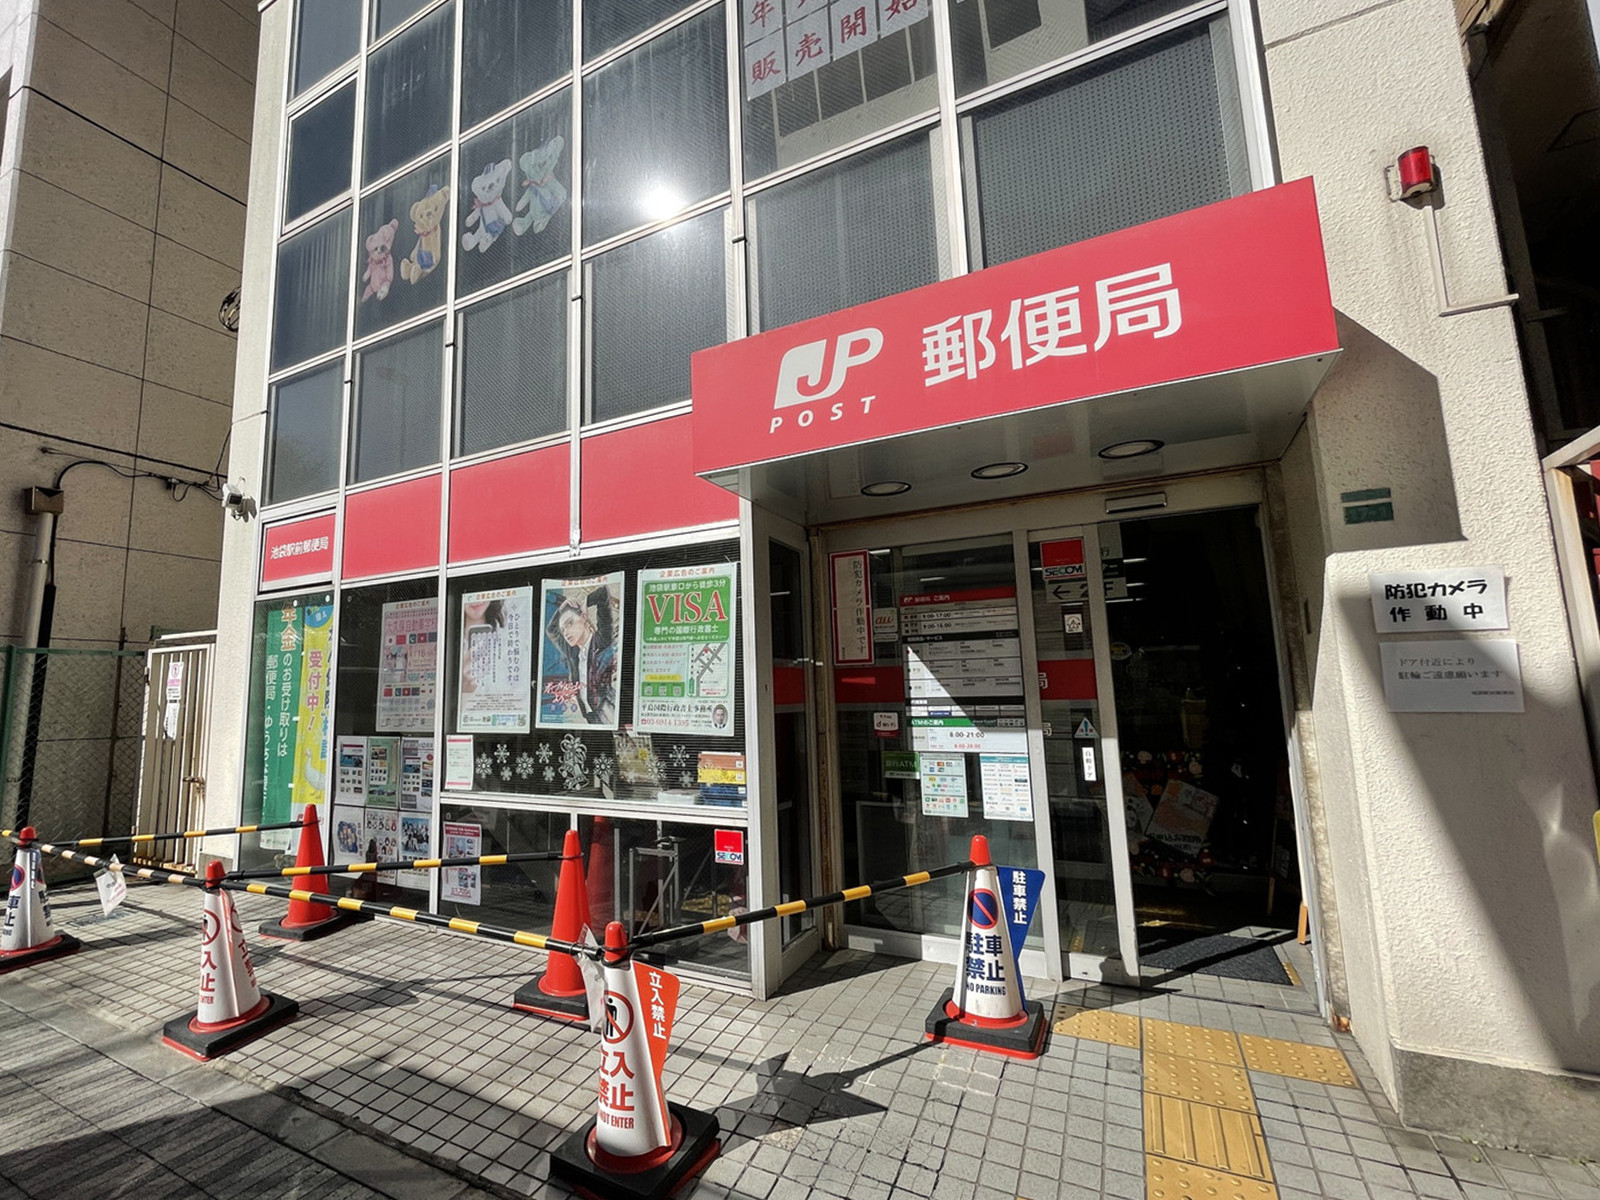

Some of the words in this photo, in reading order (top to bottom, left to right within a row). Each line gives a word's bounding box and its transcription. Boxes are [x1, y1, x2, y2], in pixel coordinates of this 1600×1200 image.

[751, 0, 919, 86] 販売開始
[922, 262, 1182, 388] 郵便局
[774, 327, 884, 410] JP
[769, 396, 877, 434] POST
[270, 536, 329, 559] 池袋駅前郵便局
[1045, 565, 1083, 577] SECOM
[1385, 579, 1487, 600] 防犯カメラ
[646, 590, 728, 624] VISA
[853, 560, 867, 655] 防犯カメラ作動中です
[875, 616, 893, 625] au
[1398, 657, 1476, 667] ドア付近により
[277, 606, 297, 757] 年金のお受け取りは
[717, 852, 742, 861] SECOM
[1012, 871, 1028, 925] 駐車禁止
[966, 932, 1003, 957] 駐車
[966, 956, 1006, 983] 禁止
[976, 985, 1006, 996] PARKING
[649, 972, 667, 1040] 立入禁止
[611, 1115, 635, 1129] ENTER
